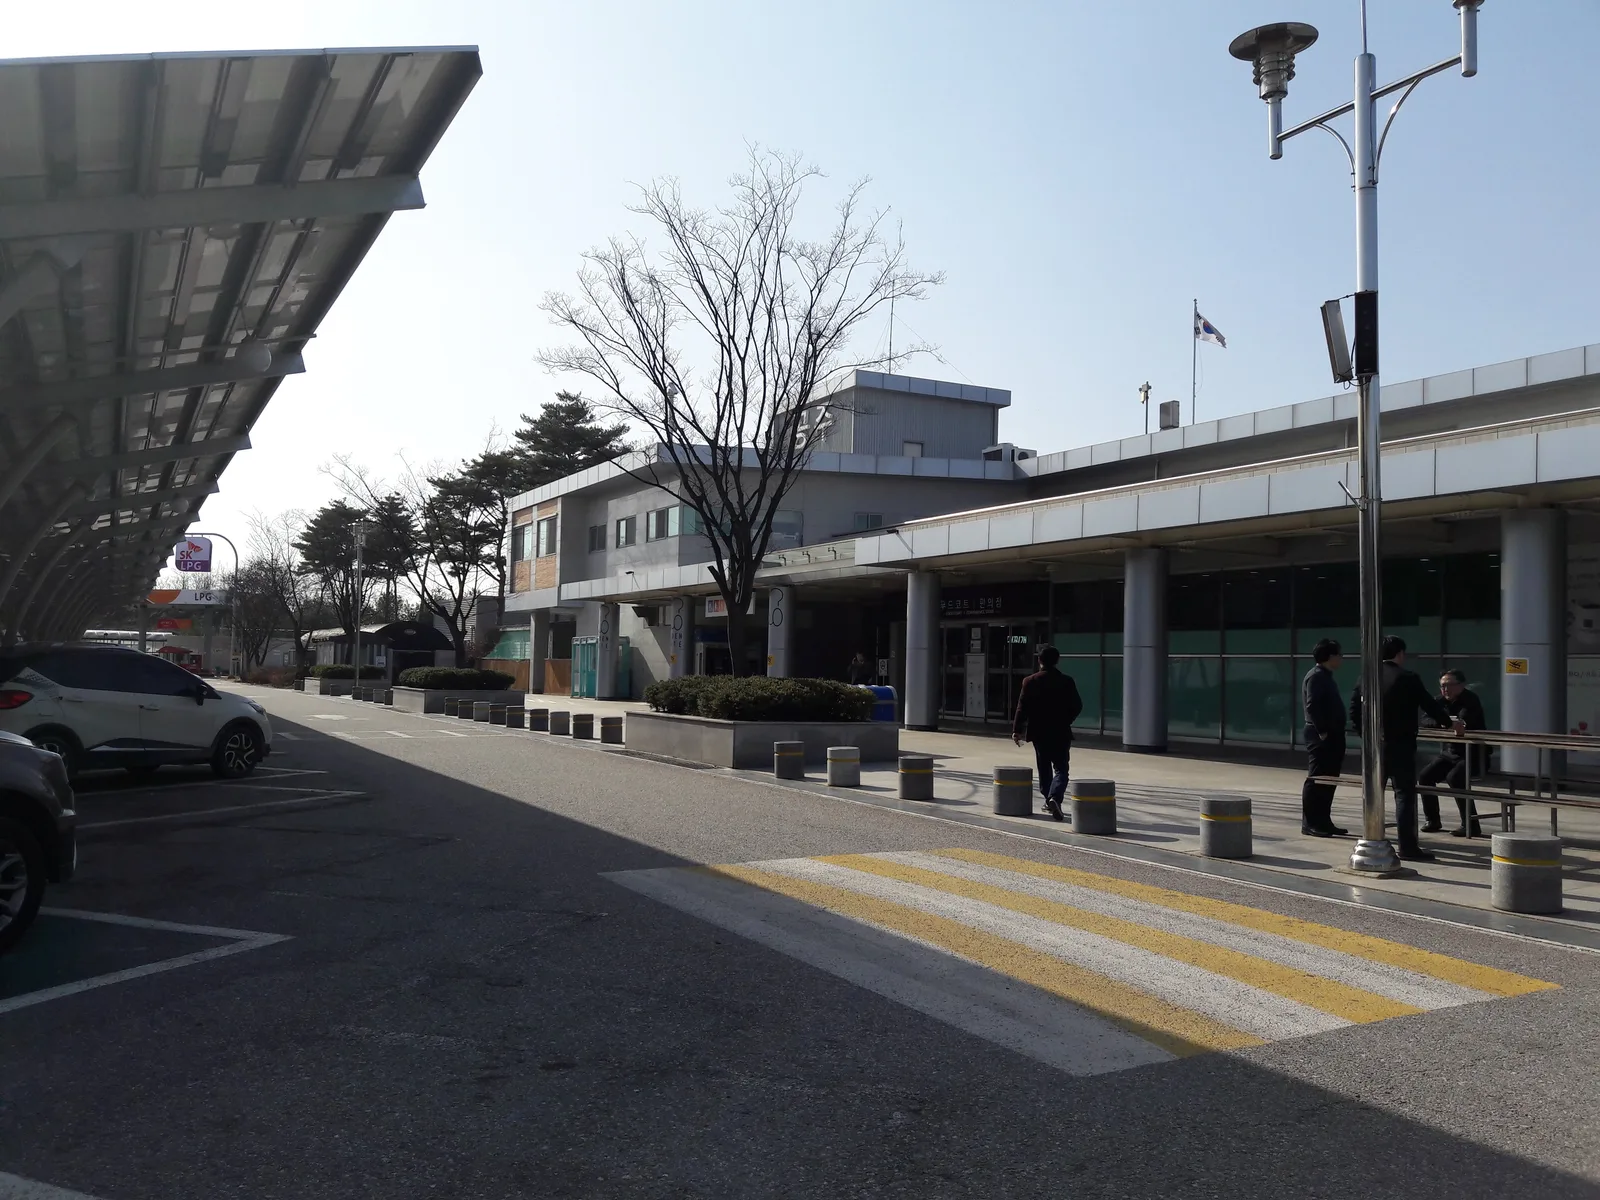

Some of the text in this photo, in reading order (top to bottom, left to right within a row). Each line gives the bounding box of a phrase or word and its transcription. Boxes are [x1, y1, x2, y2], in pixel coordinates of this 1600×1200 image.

[179, 550, 193, 560] SK
[180, 561, 202, 571] LPG
[194, 592, 213, 602] LPG
